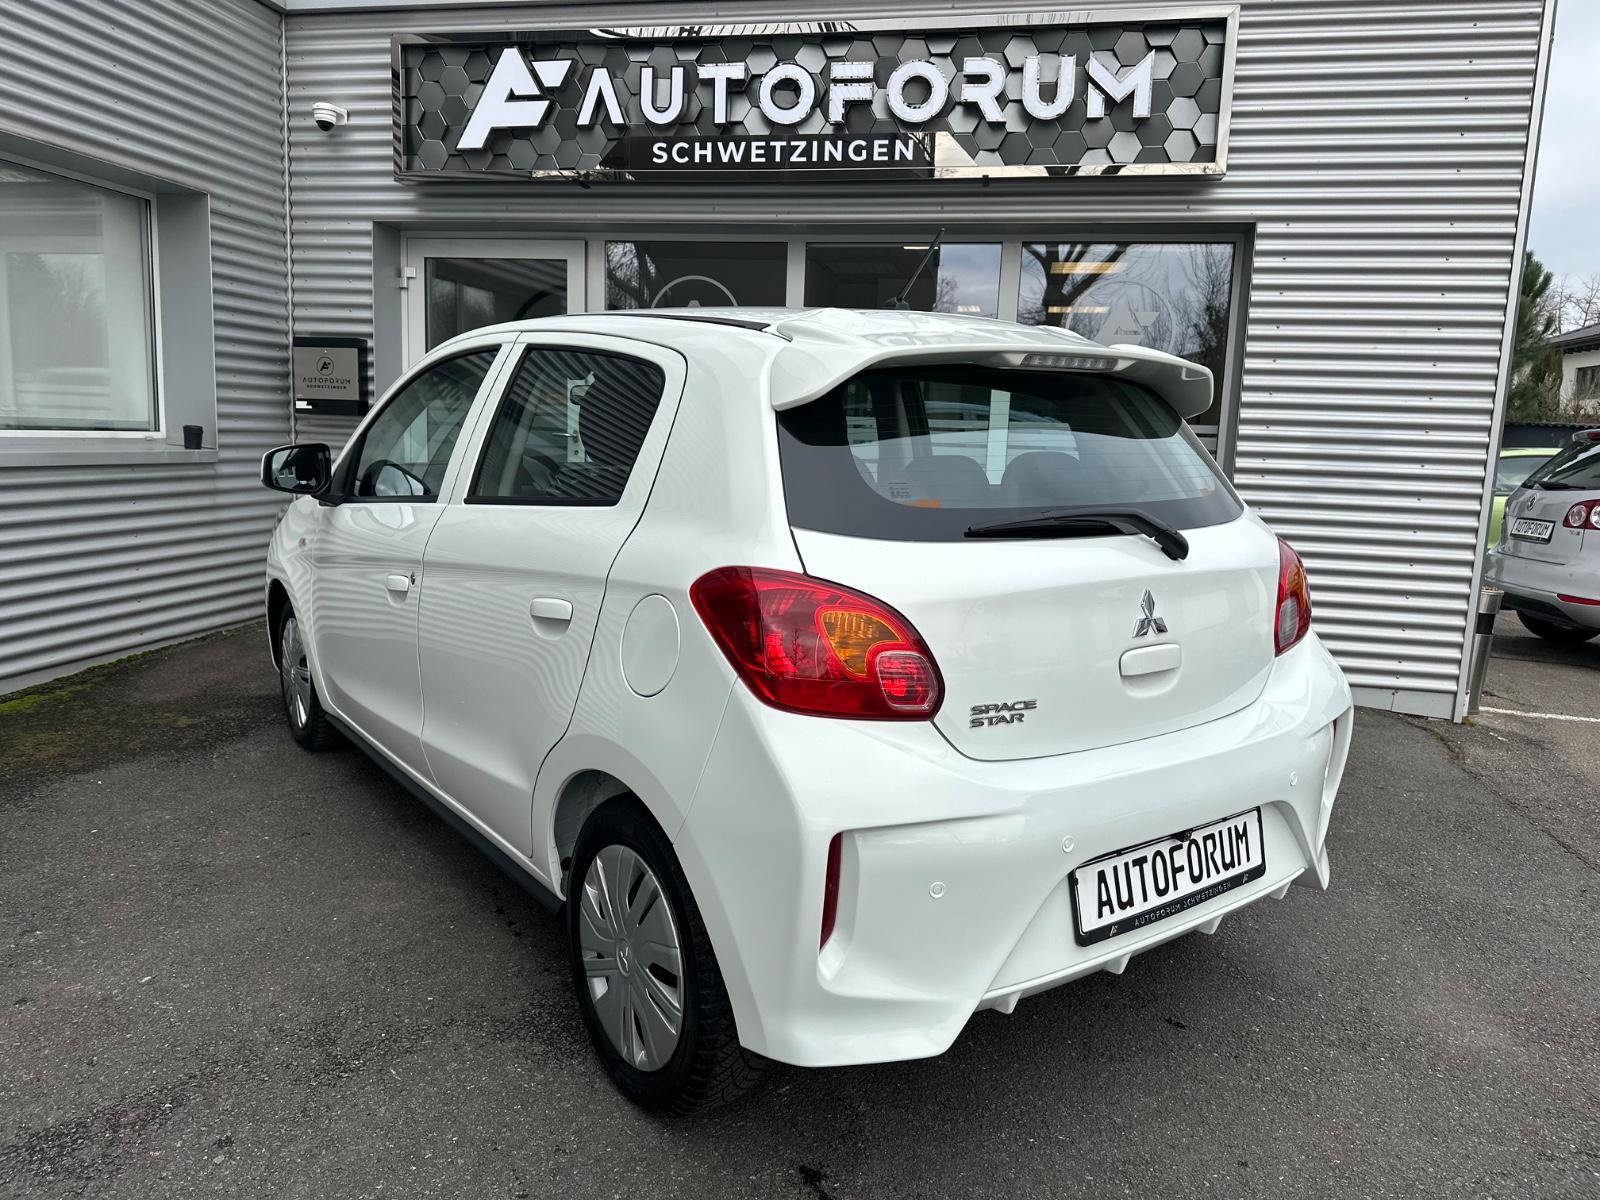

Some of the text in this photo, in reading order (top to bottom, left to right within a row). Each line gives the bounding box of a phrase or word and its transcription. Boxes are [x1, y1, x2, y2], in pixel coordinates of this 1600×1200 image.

[576, 49, 1156, 127] AUTOFORUM
[651, 139, 915, 164] SCHWETZINGEN
[1515, 521, 1550, 536] AUTOFORUM
[970, 699, 1038, 716] SPACE
[969, 713, 1025, 728] STAR
[1097, 821, 1251, 919] AUTOFORUM
[1134, 903, 1181, 927] AUTOFORUM
